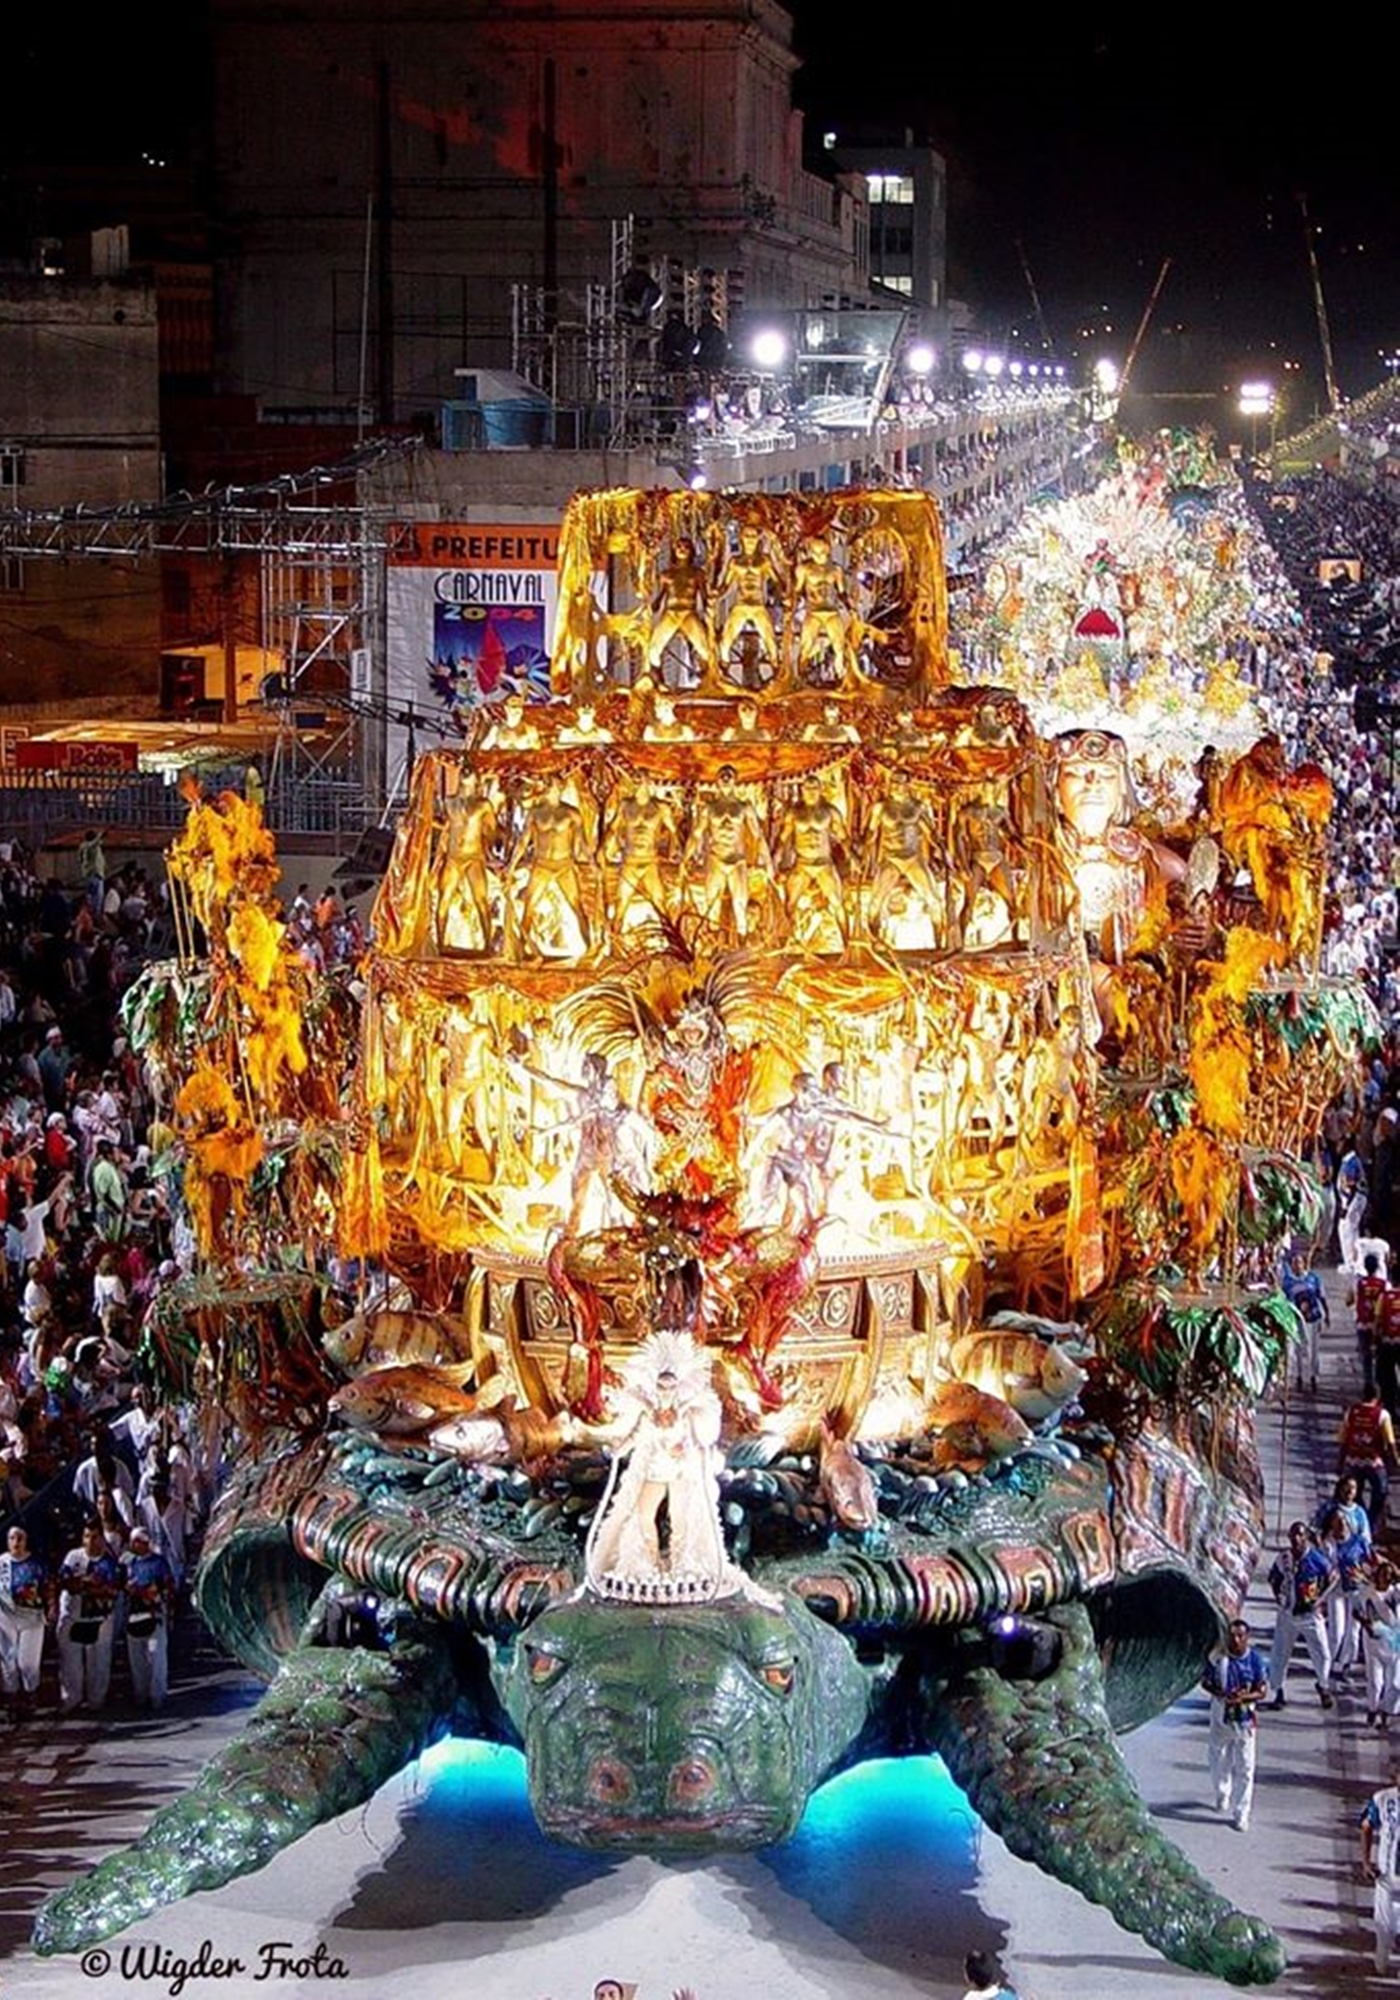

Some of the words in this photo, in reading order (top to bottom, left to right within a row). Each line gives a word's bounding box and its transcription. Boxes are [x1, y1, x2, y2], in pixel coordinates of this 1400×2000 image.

[432, 536, 558, 561] PREFEITU
[434, 572, 546, 602] CARNAVAL
[443, 604, 537, 622] 2004
